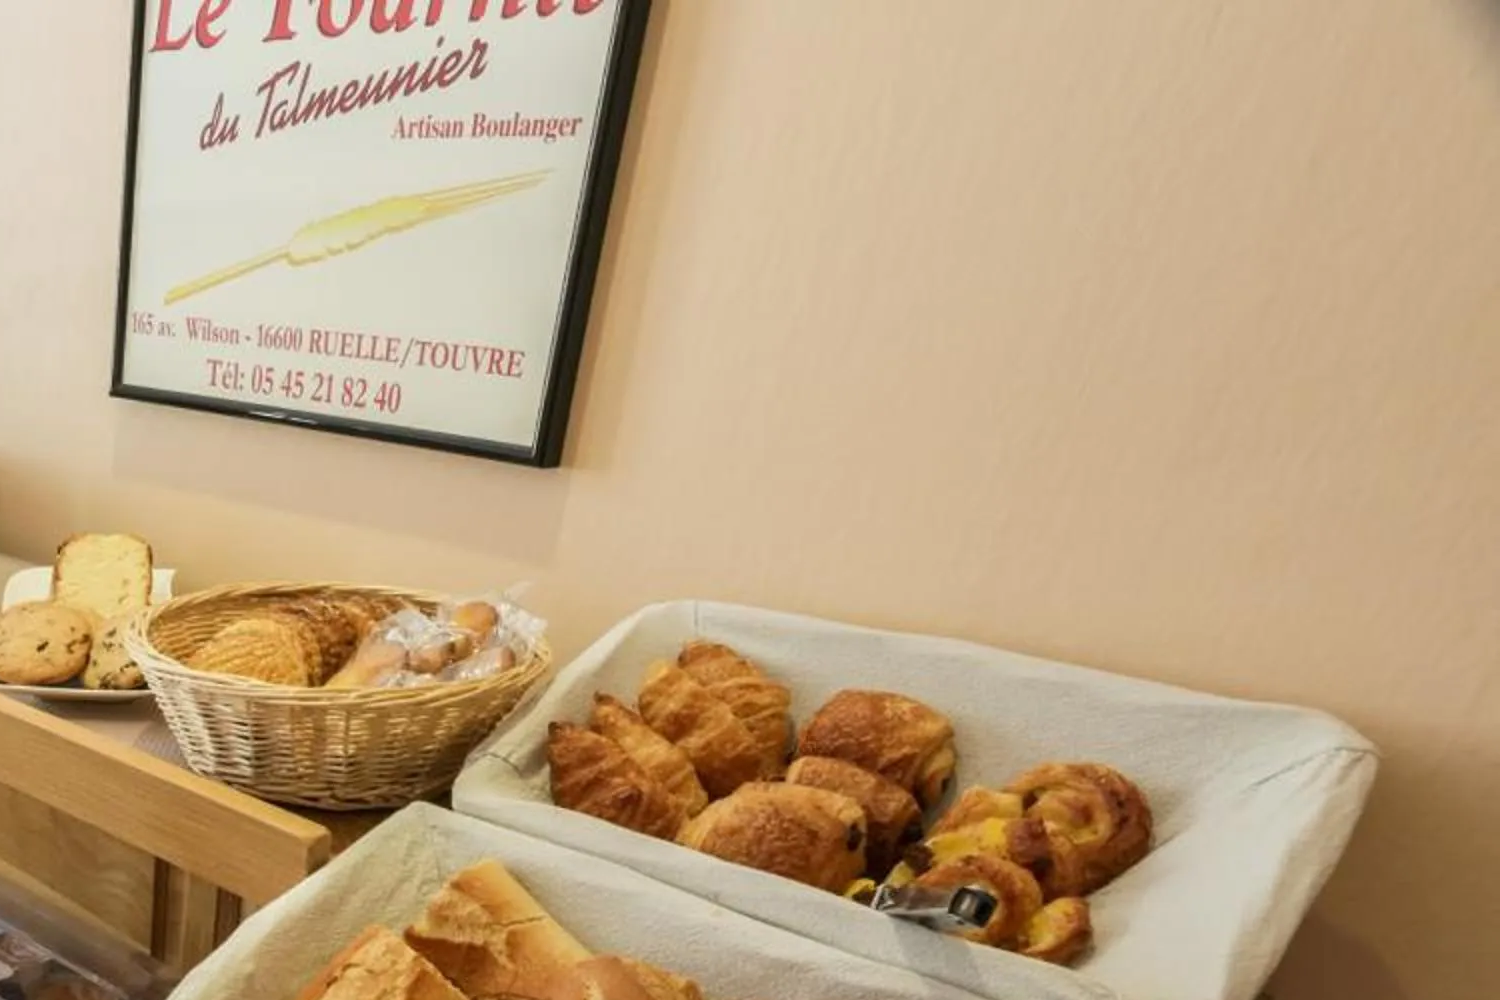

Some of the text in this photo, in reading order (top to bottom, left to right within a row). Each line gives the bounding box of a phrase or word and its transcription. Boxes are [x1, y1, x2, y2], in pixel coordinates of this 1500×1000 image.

[199, 38, 489, 150] du Talmeunier
[392, 114, 583, 142] Artisan Boulanger
[131, 312, 155, 335] 165
[157, 320, 176, 338] av.
[185, 317, 240, 345] Wilson
[257, 327, 303, 353] 16600
[308, 330, 525, 379] RUELLE/TOUVRE
[207, 360, 401, 413] Tél: 05 45 21 82 40
